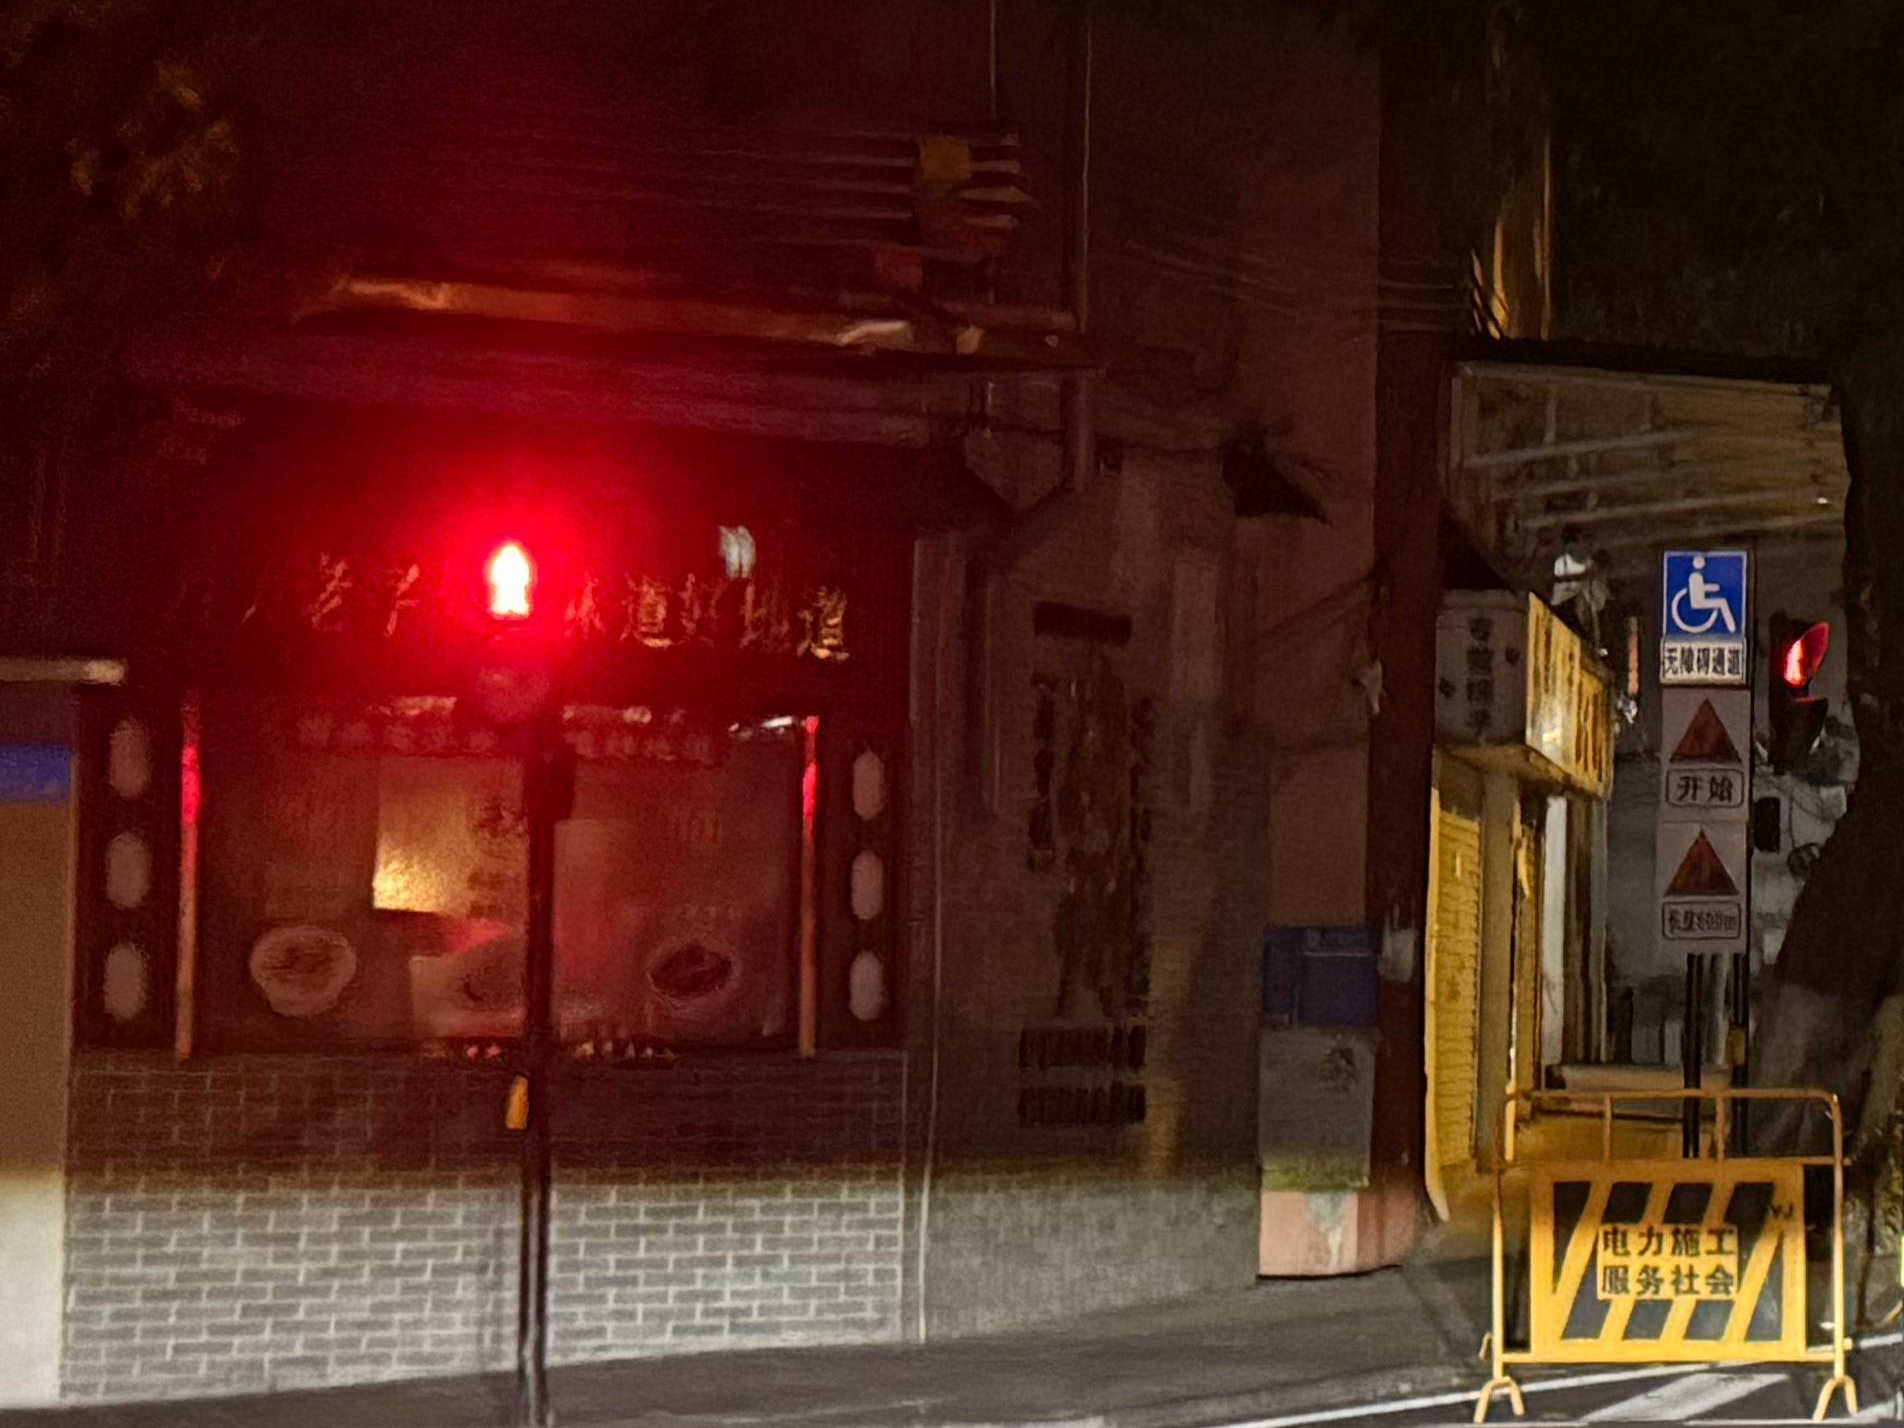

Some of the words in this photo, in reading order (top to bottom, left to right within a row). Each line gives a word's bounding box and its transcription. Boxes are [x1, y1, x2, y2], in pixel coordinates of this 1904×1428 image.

[1677, 775, 1734, 803] 开始
[1602, 1225, 1735, 1257] 电力施工
[1602, 1263, 1734, 1296] 服务社会
